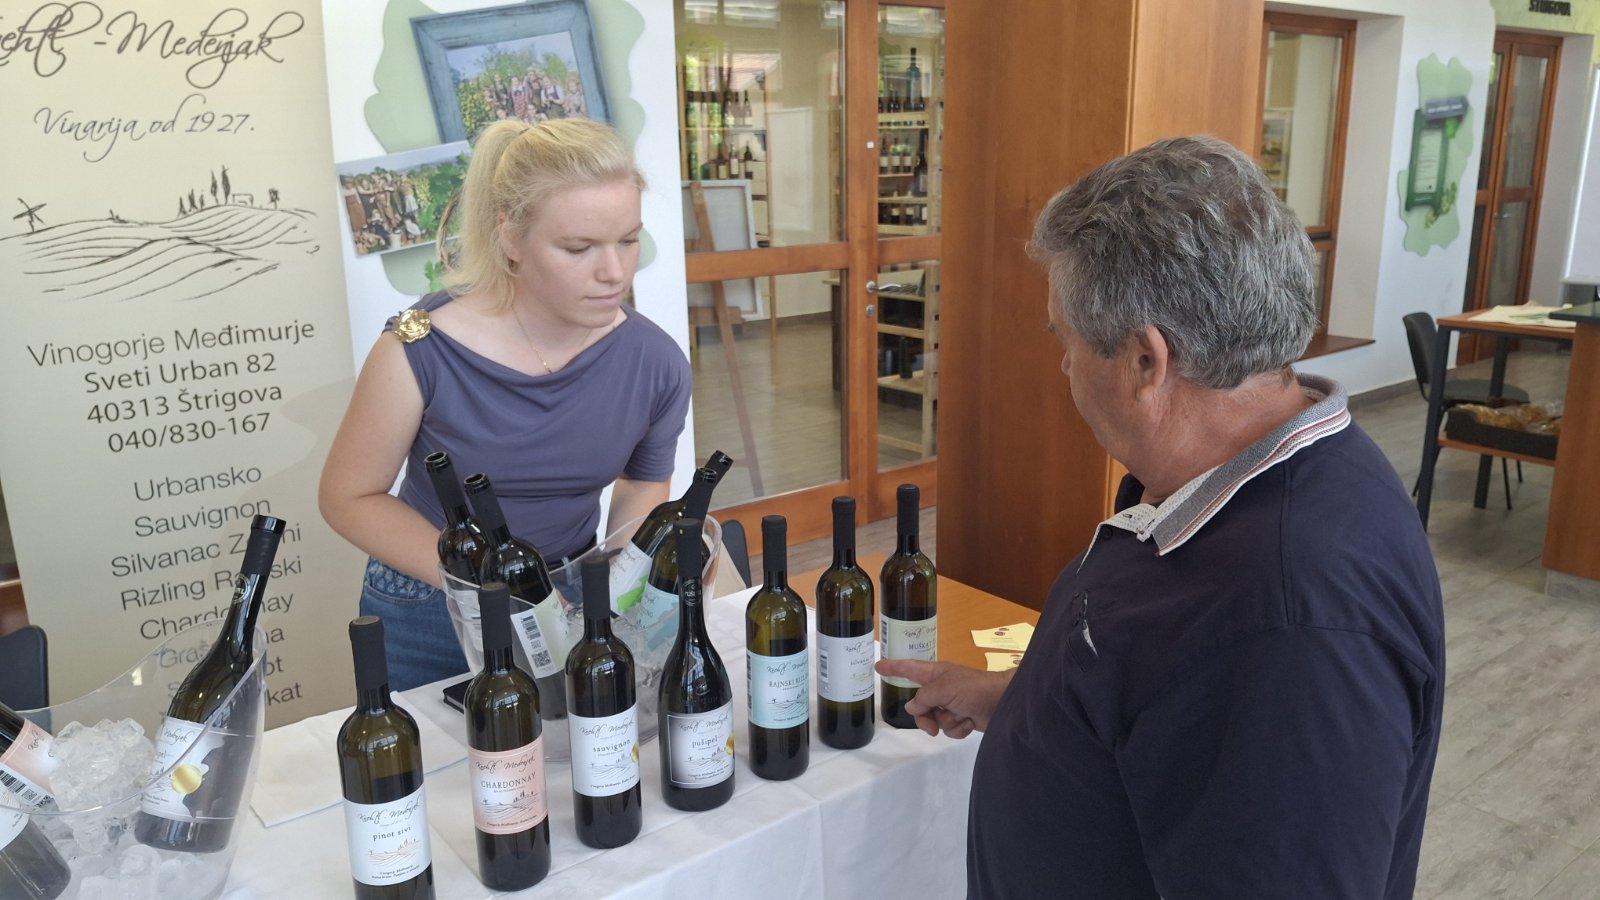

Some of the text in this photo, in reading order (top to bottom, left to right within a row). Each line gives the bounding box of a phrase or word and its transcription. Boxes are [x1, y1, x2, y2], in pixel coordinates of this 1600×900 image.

[34, 94, 254, 162] Vinarija od 1927.
[27, 320, 315, 367] Vinogorje Međimurje
[85, 353, 277, 393] Sveti Urban 82
[87, 386, 282, 424] 40313 Štrigova
[108, 412, 271, 453] 040/830-167
[134, 466, 262, 501] Urbansko
[135, 499, 271, 537] Sauvignon
[111, 541, 221, 577] Silvanac
[121, 578, 206, 610] Rizling
[593, 739, 631, 752] sauvignon
[481, 772, 536, 789] CHARDONNAY
[373, 826, 412, 841] pinot sivi
